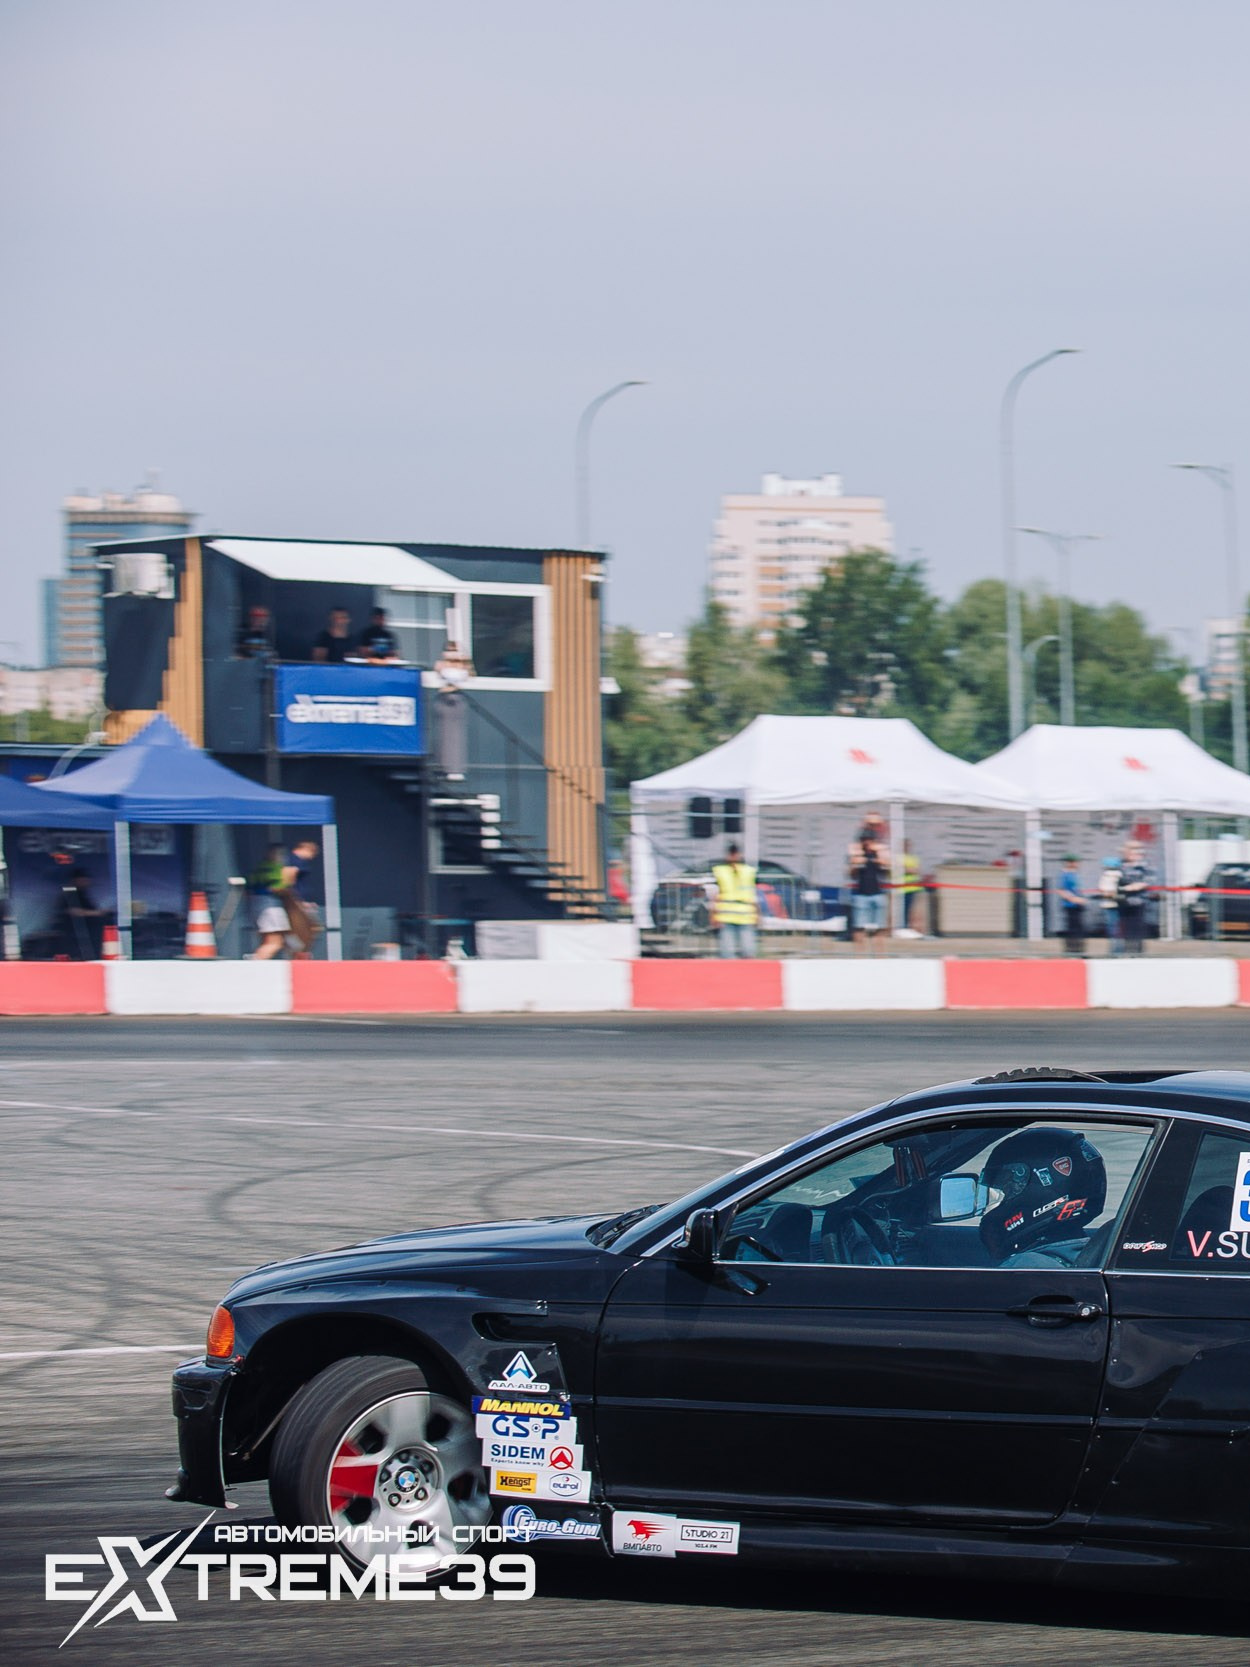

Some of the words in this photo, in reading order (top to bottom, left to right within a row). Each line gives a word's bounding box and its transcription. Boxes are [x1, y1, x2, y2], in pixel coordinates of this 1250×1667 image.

[480, 1398, 564, 1417] MANNOL
[490, 1443, 545, 1460] SIDEM
[499, 1475, 533, 1488] Hengst
[684, 1529, 718, 1539] STUDIO
[719, 1530, 730, 1540] 21
